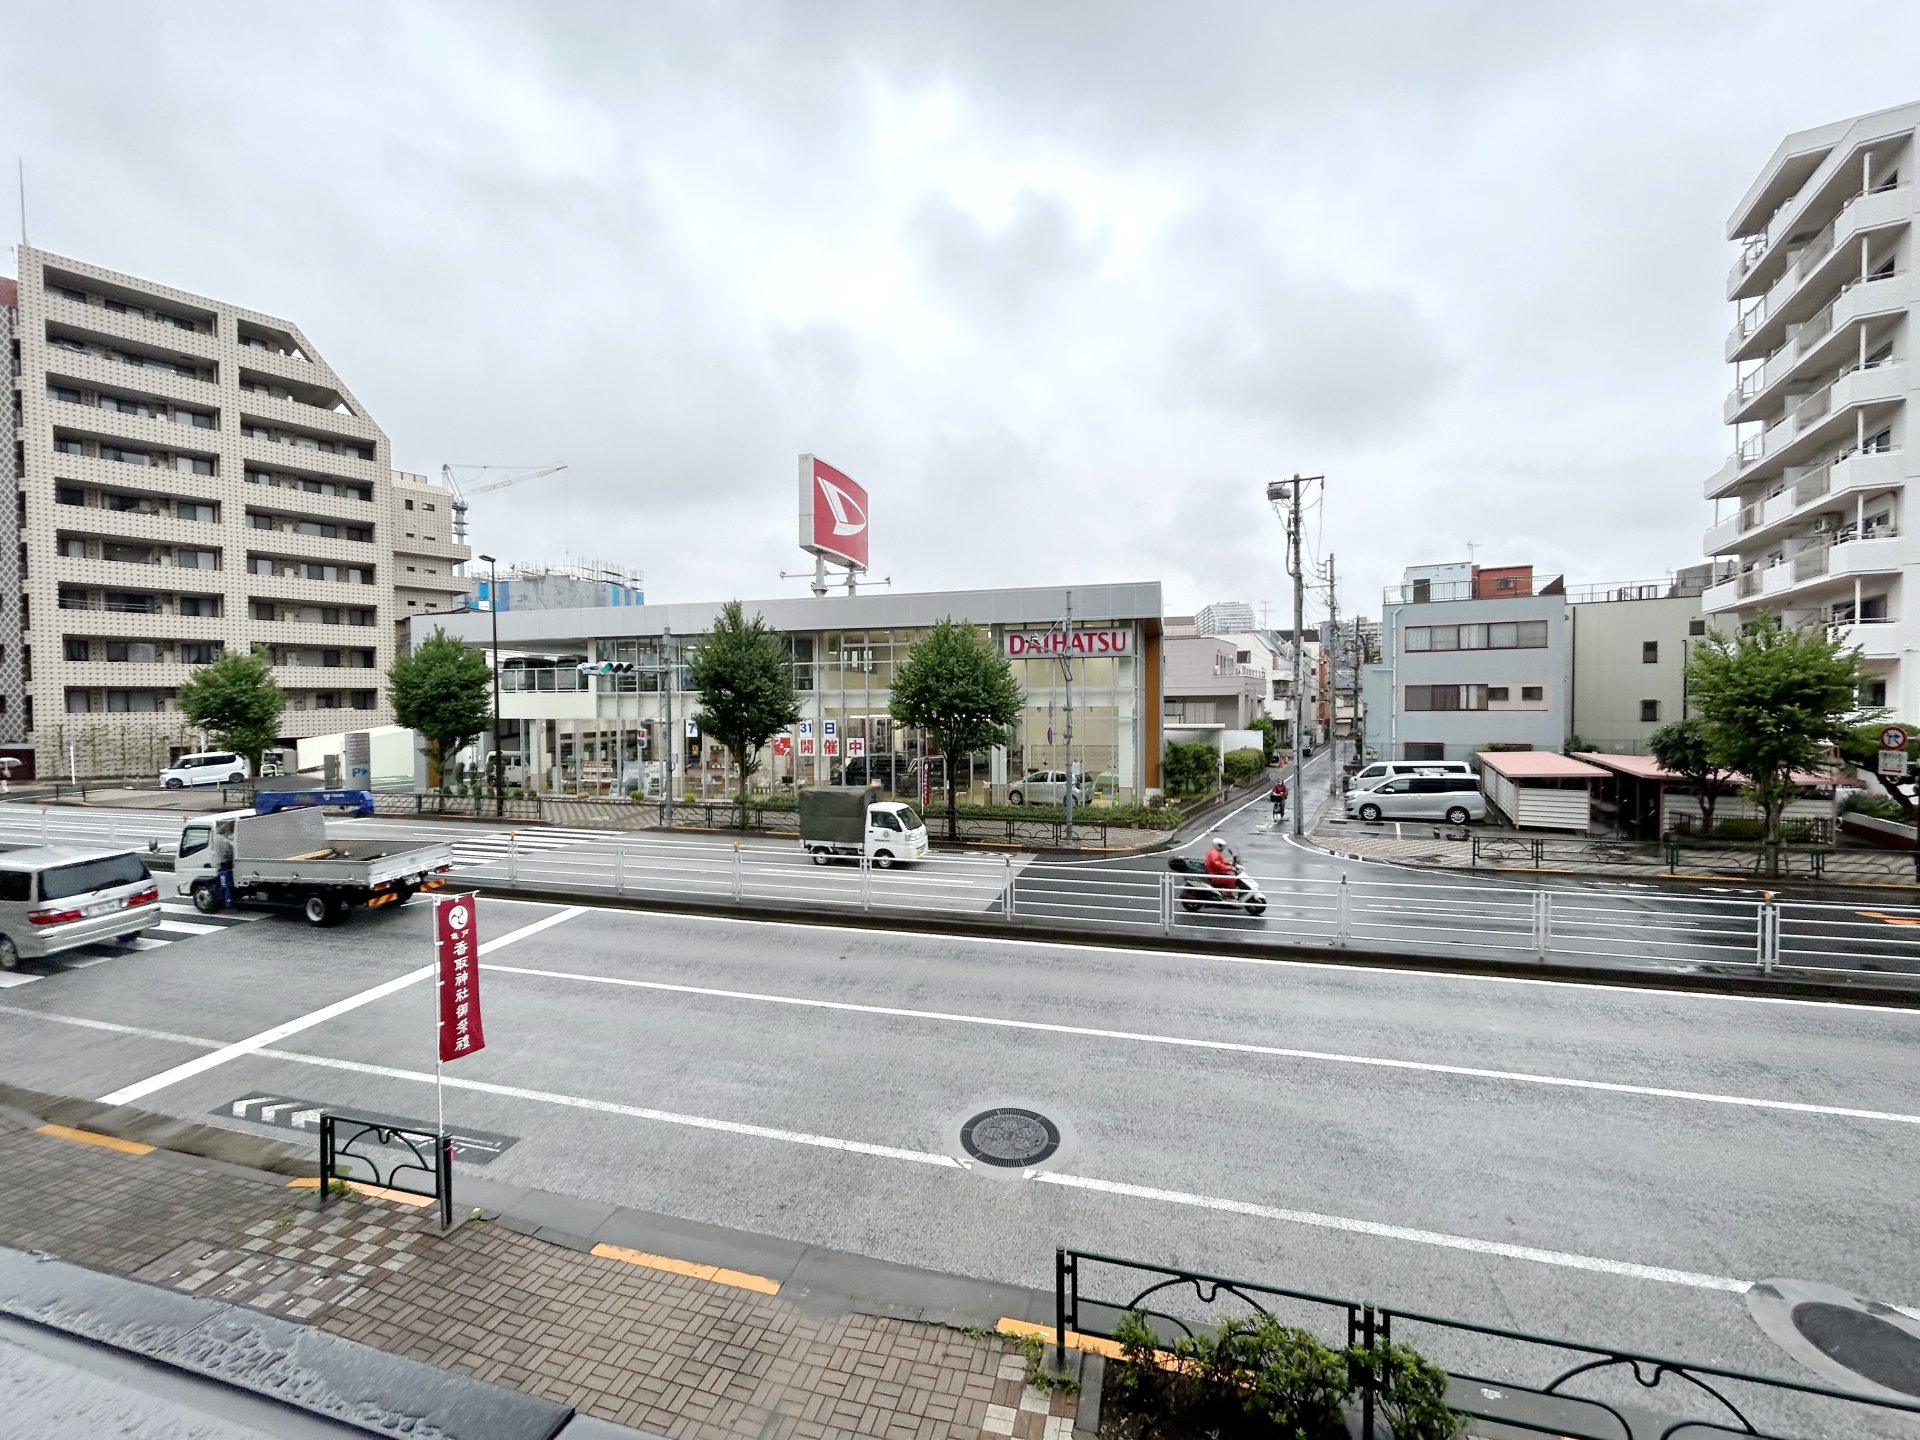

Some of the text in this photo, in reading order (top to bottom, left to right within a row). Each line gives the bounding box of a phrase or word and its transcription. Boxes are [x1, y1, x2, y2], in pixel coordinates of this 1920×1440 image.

[1009, 631, 1126, 655] DAIHATSU
[800, 740, 862, 755] 開催中
[352, 768, 360, 777] P
